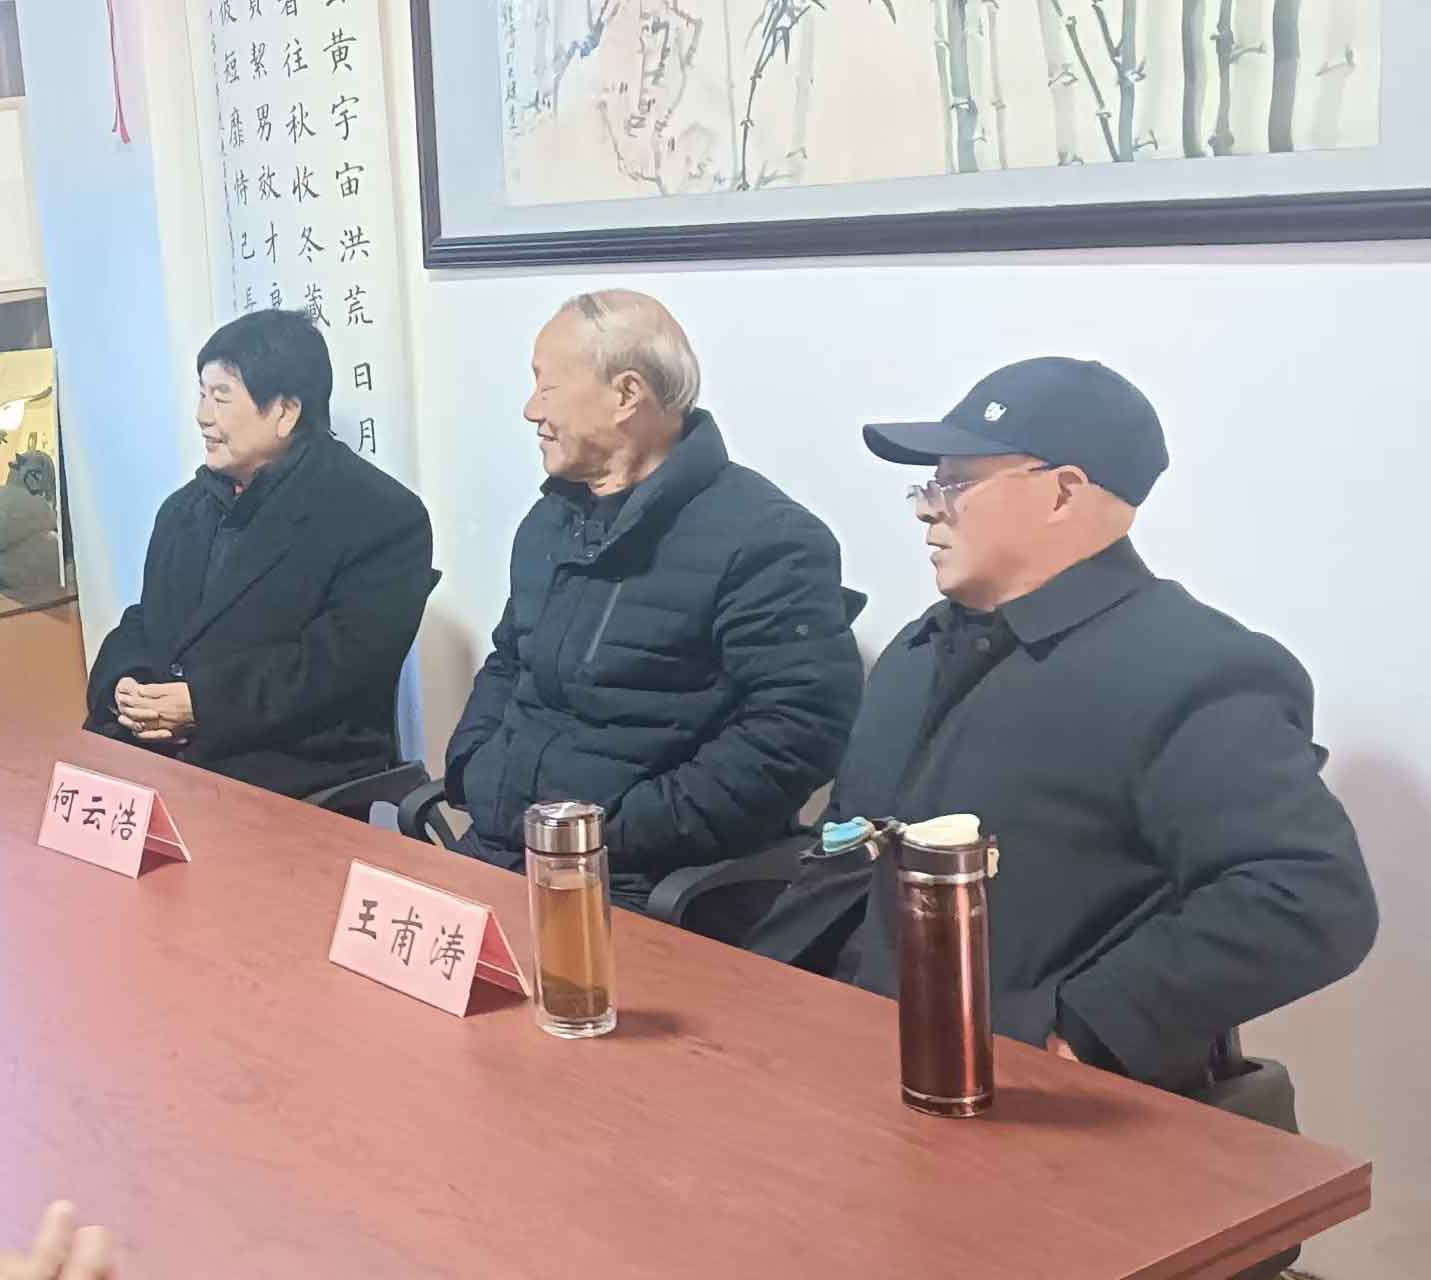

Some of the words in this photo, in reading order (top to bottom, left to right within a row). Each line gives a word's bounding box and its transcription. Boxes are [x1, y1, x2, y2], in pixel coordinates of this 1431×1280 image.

[322, 0, 378, 454] 黄宇宙洪荒日月
[52, 782, 138, 842] 何云浩
[348, 899, 466, 981] 王甫涛
